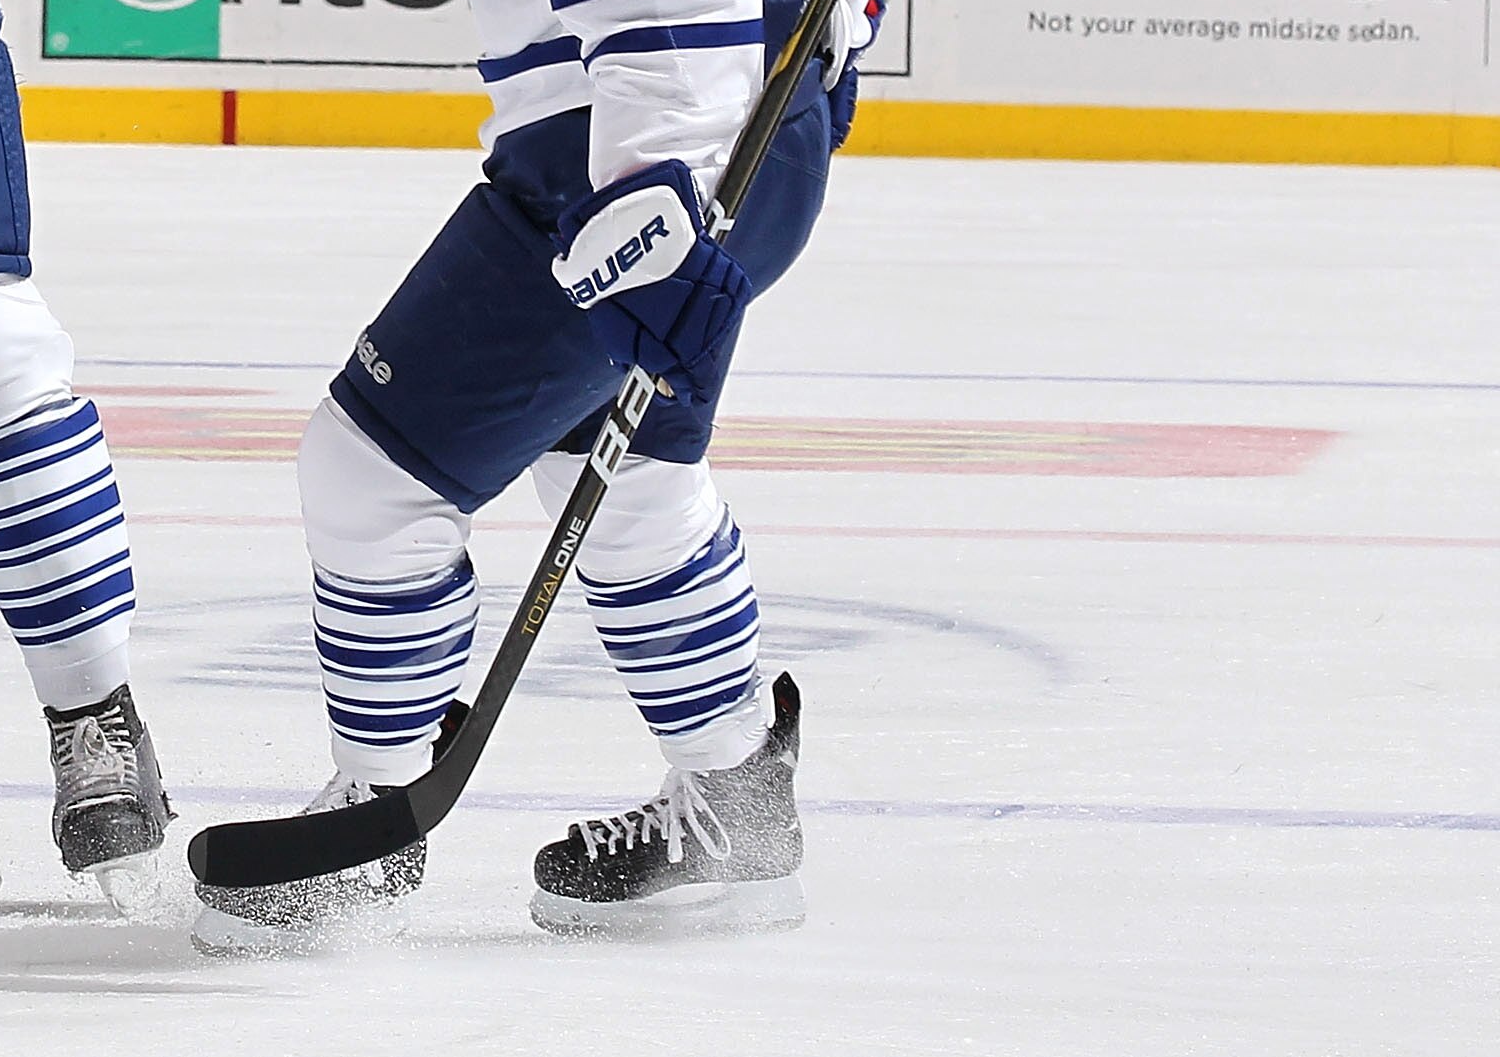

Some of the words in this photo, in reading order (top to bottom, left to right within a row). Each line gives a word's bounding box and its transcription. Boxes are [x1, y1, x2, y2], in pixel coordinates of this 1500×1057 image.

[1027, 11, 1073, 34] Not
[1082, 14, 1134, 37] your
[1145, 18, 1240, 40] average
[1249, 17, 1340, 42] midsize
[1348, 19, 1421, 43] sedan.
